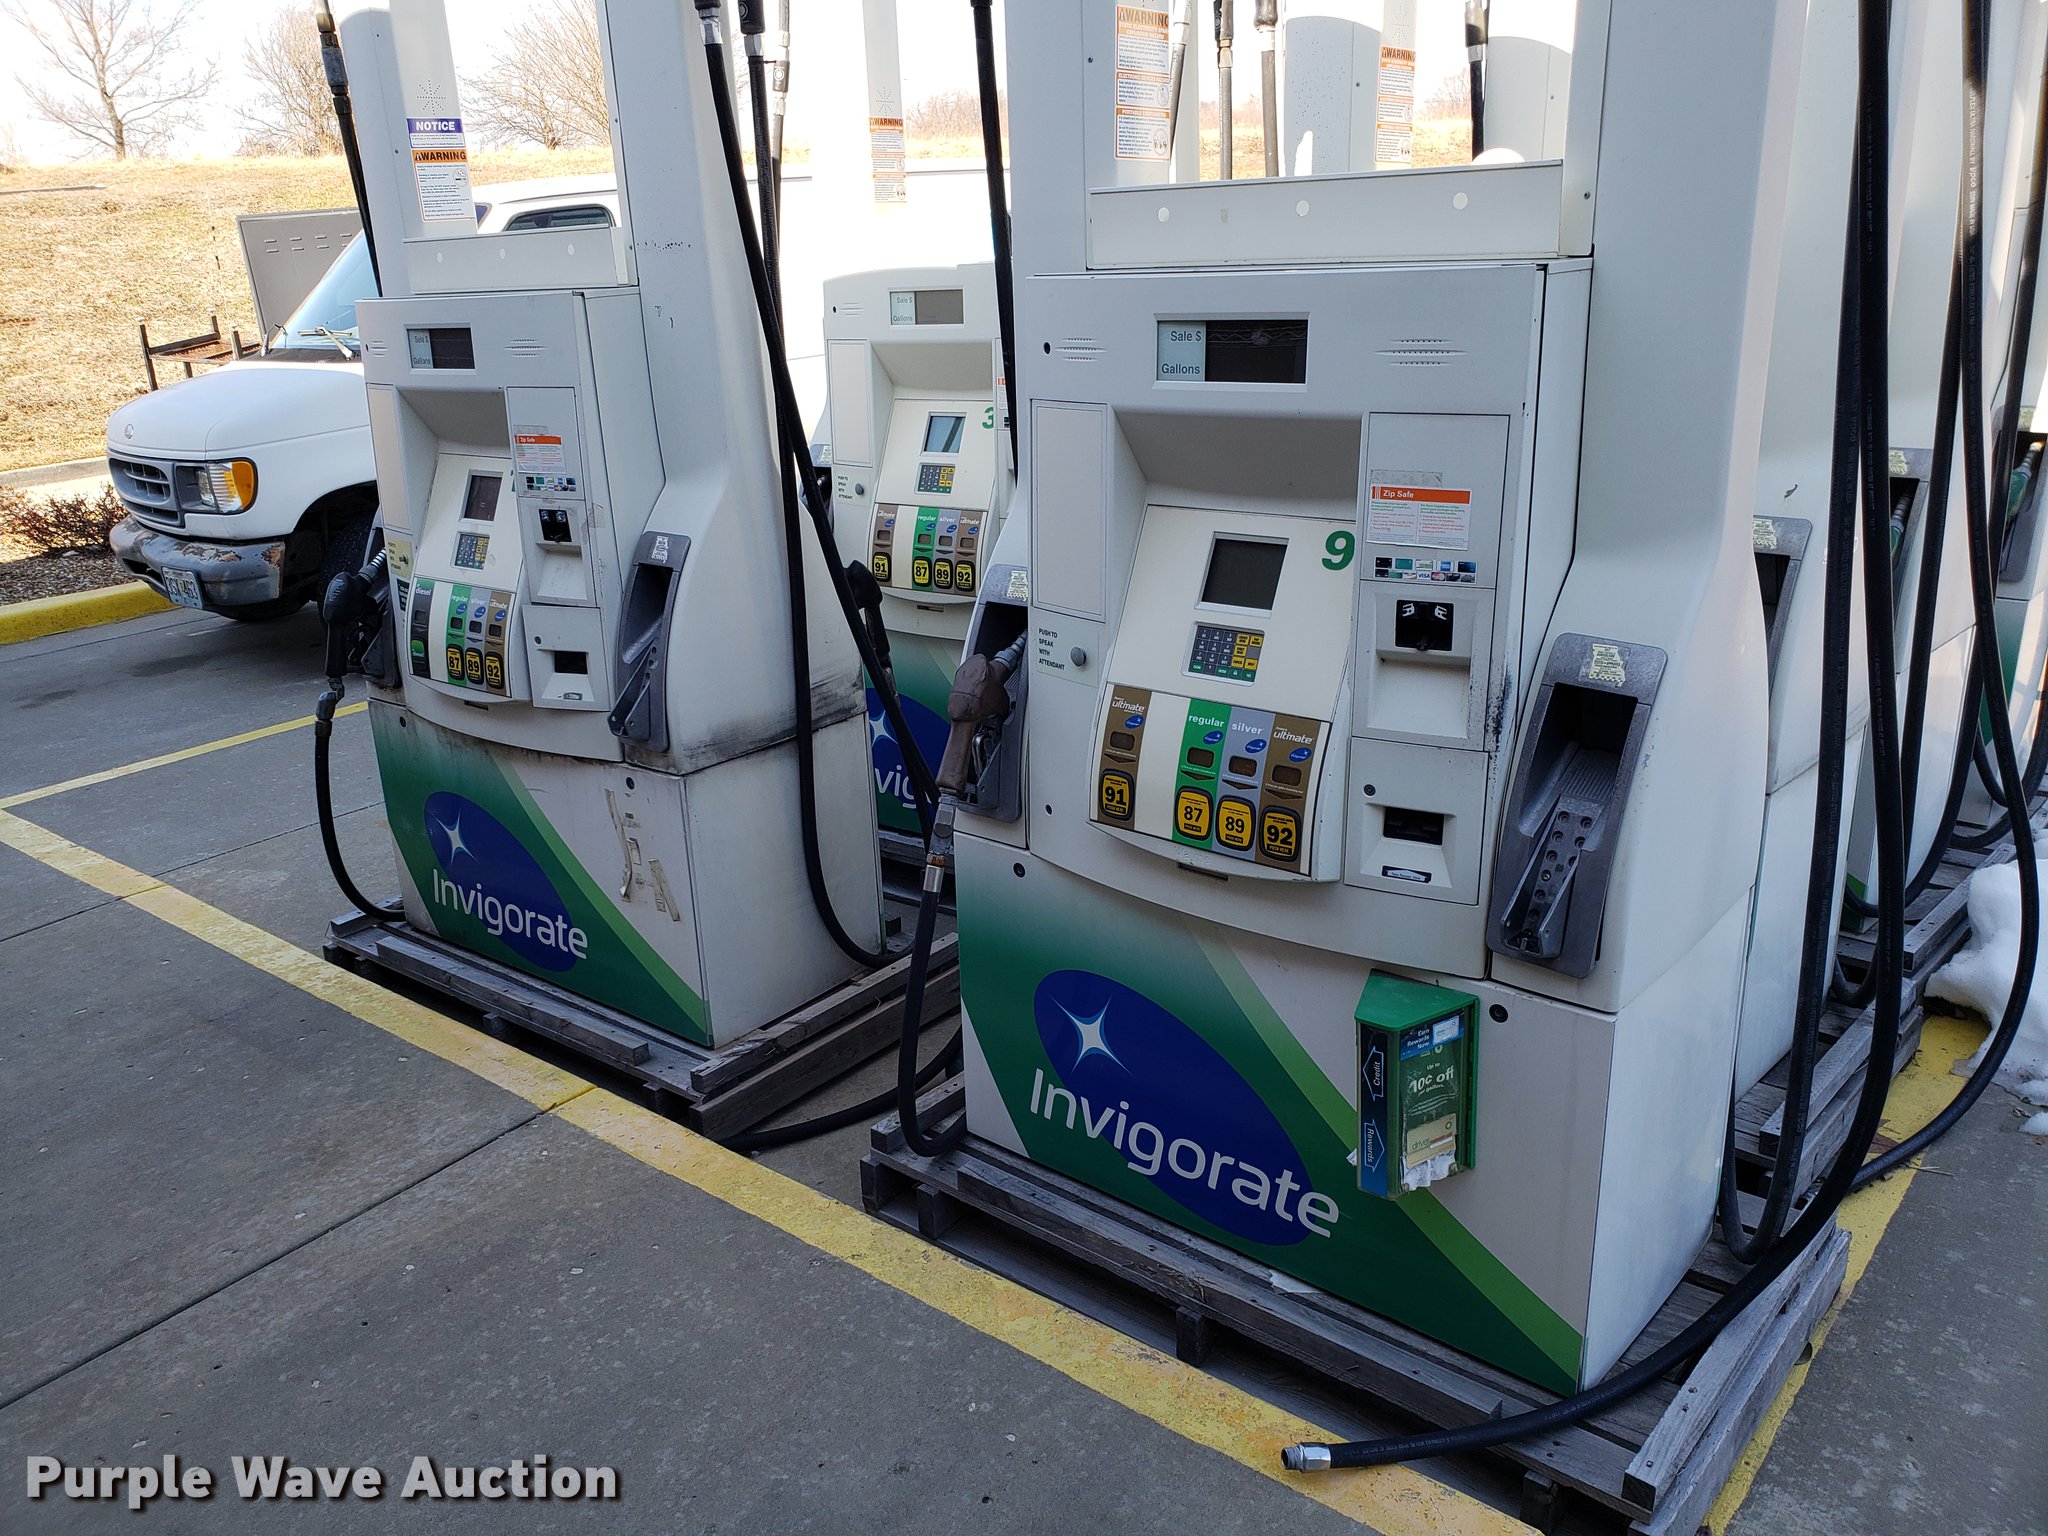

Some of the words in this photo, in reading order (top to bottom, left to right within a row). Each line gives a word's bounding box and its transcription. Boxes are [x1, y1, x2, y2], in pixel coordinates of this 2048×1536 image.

[415, 121, 456, 131] NOTICE
[874, 117, 903, 127] WARNING
[421, 151, 467, 161] WARNING
[1170, 330, 1193, 342] Sale
[1161, 363, 1201, 375] Gallons
[982, 406, 995, 430] 3
[1383, 489, 1396, 498] Zip
[1397, 490, 1414, 499] Safe
[1322, 530, 1356, 571] 9
[875, 562, 887, 573] 91
[915, 566, 927, 577] 87
[936, 569, 948, 580] 89
[957, 572, 970, 583] 92
[415, 587, 432, 596] diesel
[1038, 628, 1051, 636] PUSH
[1038, 638, 1054, 647] SPEAK
[1038, 648, 1050, 656] WITH
[449, 656, 460, 669] 87
[467, 660, 479, 672] 89
[1038, 658, 1065, 670] ATTENDANT
[487, 665, 500, 678] 92
[1112, 700, 1145, 712] ultimate
[1188, 715, 1224, 727] regular
[1231, 722, 1263, 734] silver
[1273, 731, 1313, 744] ultimate
[1105, 786, 1127, 807] 91
[1184, 806, 1203, 822] 87
[1225, 816, 1245, 834] 89
[1267, 825, 1293, 846] 92
[433, 868, 588, 960] Invigorate
[1407, 1034, 1430, 1047] Rewards
[1373, 1061, 1381, 1086] Credit
[1436, 1065, 1454, 1083] off
[1367, 1128, 1375, 1163] Rewards
[1030, 1067, 1340, 1238] Invigorate
